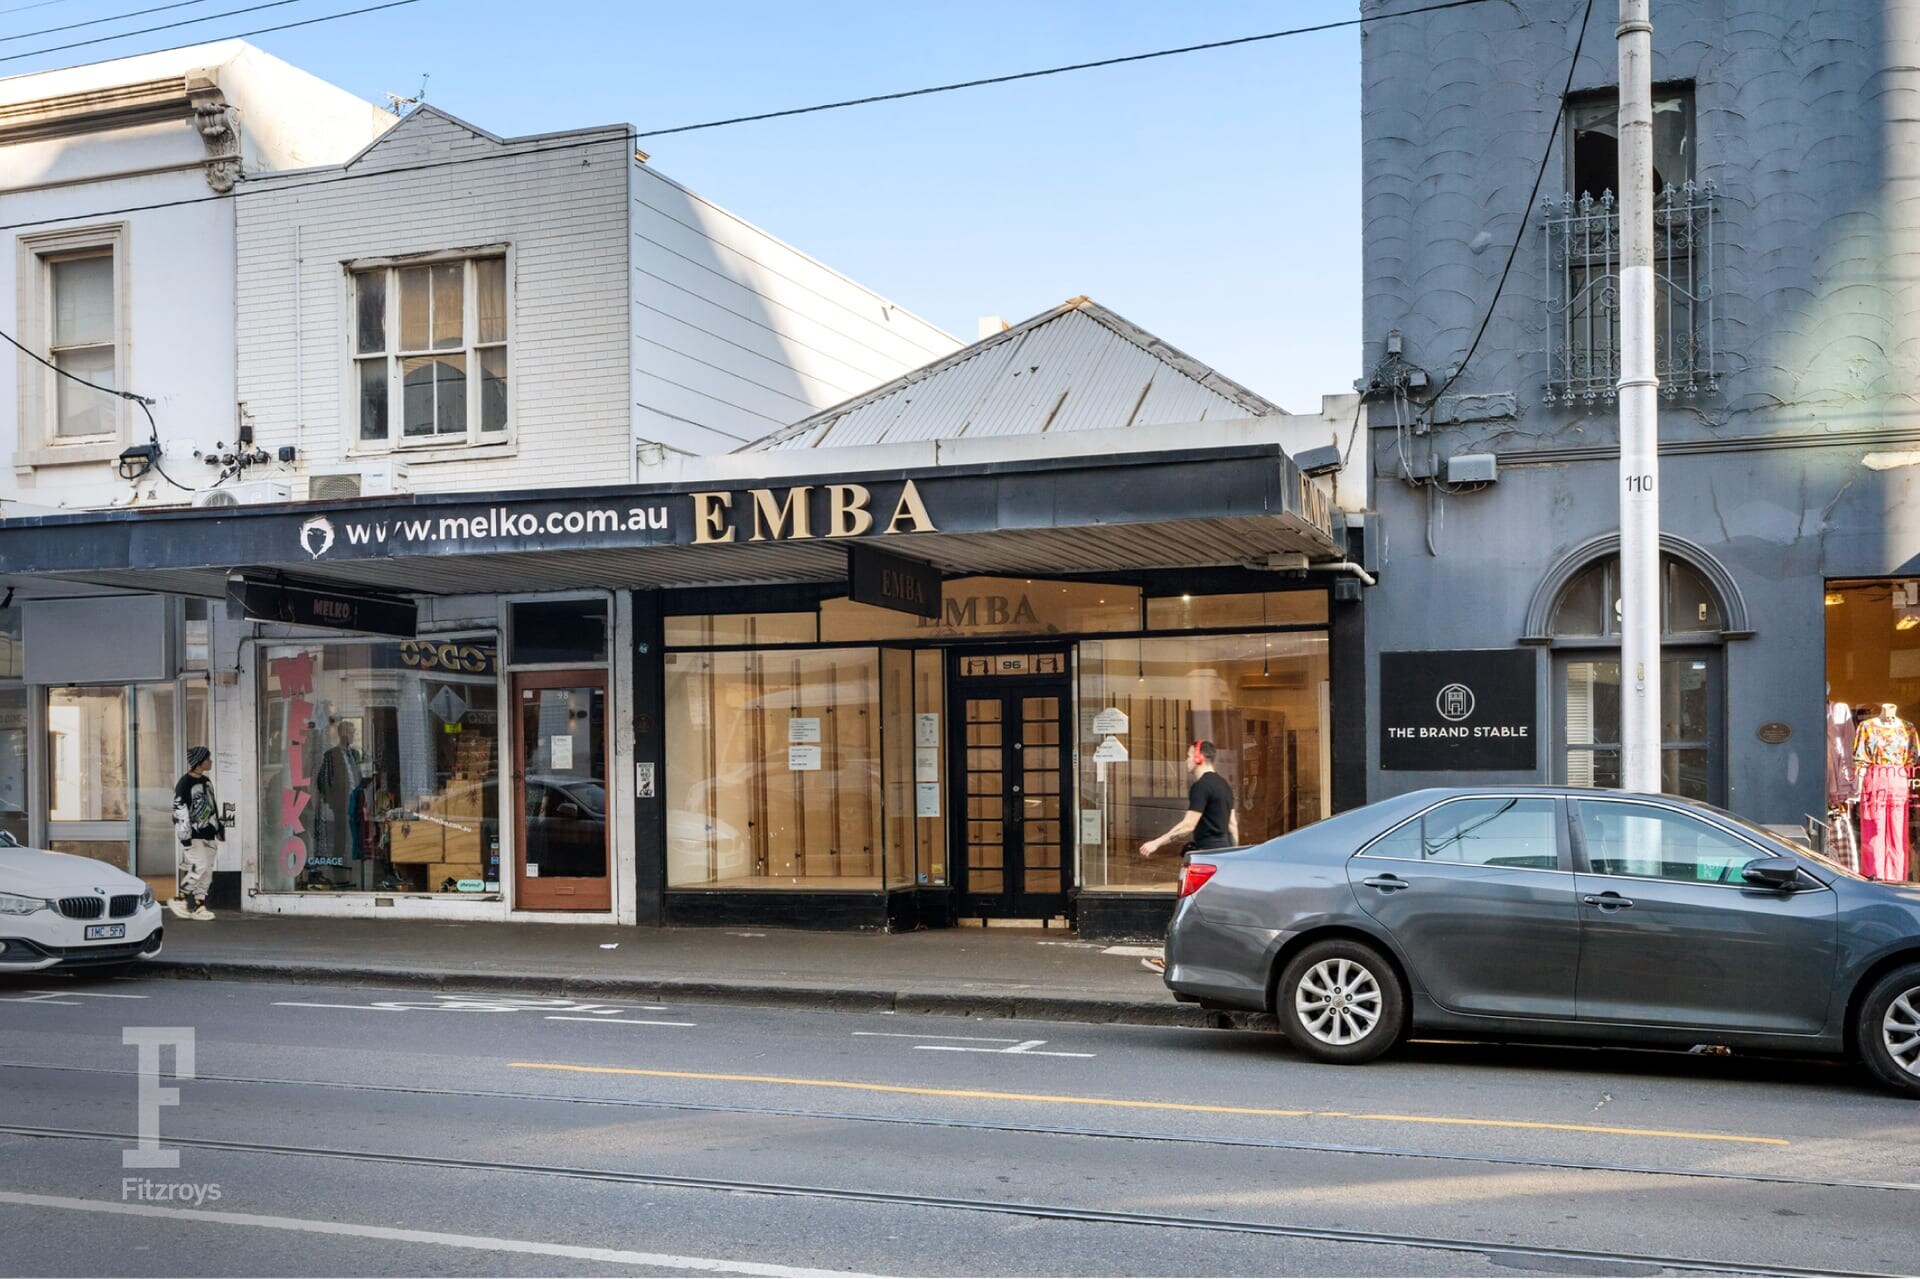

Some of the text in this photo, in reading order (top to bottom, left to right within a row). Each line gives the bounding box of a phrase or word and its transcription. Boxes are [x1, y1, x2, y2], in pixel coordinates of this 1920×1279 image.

[1625, 475, 1653, 493] 110
[689, 479, 939, 545] EMBA
[881, 569, 924, 604] EMBA
[312, 599, 350, 618] MELKO
[1002, 660, 1021, 670] 96
[1388, 726, 1528, 738] THE BRAND STABLE
[277, 650, 314, 878] MELKO
[308, 857, 344, 867] GARAGE
